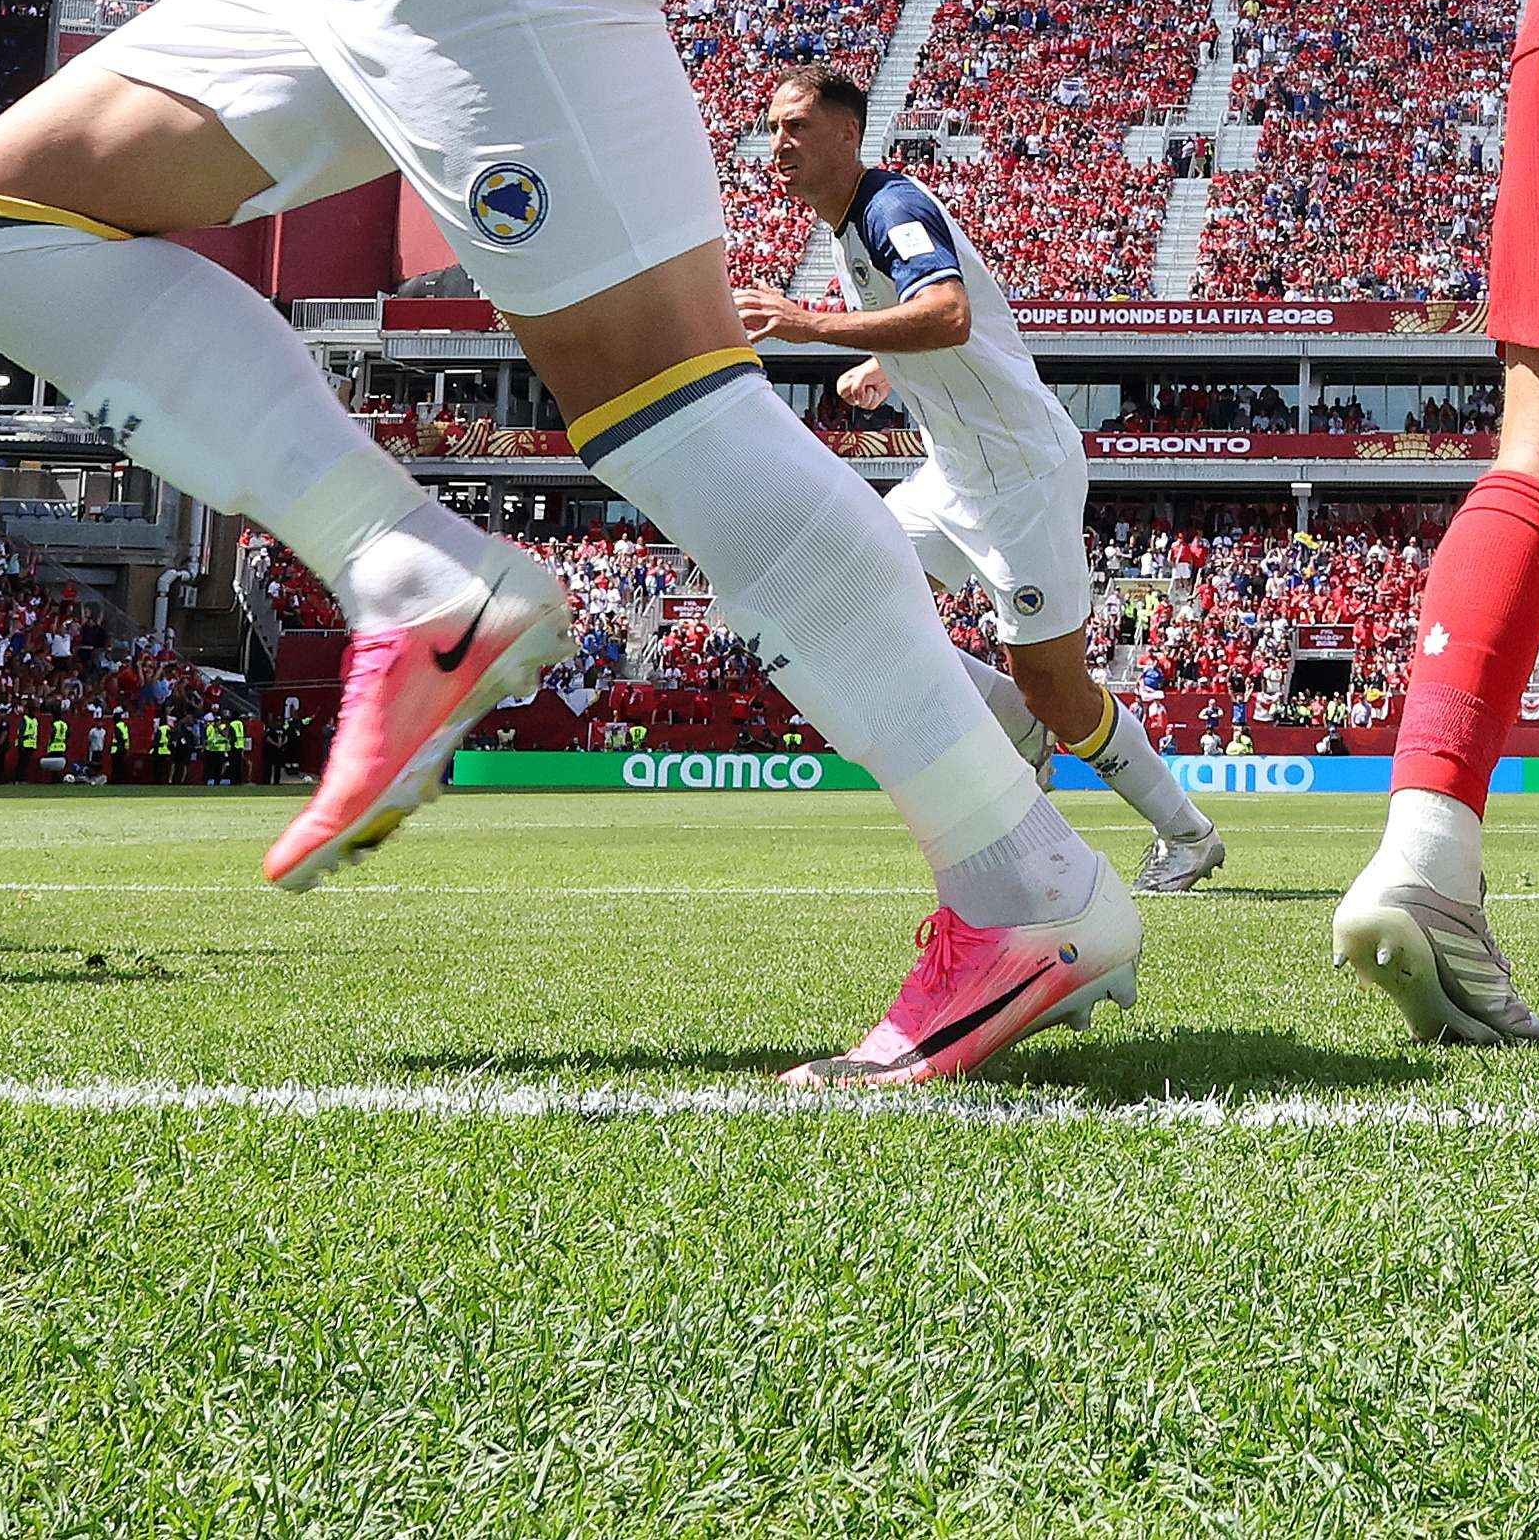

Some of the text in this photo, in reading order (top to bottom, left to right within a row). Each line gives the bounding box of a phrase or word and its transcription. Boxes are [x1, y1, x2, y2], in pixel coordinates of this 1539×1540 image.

[1071, 308, 1097, 325] DU
[1099, 308, 1167, 325] MONDE
[1169, 308, 1193, 325] DE
[1196, 308, 1220, 325] LA
[1223, 308, 1264, 325] FIFA
[1267, 308, 1335, 325] 2026
[1095, 436, 1252, 454] TORONTO
[622, 753, 824, 789] aramco
